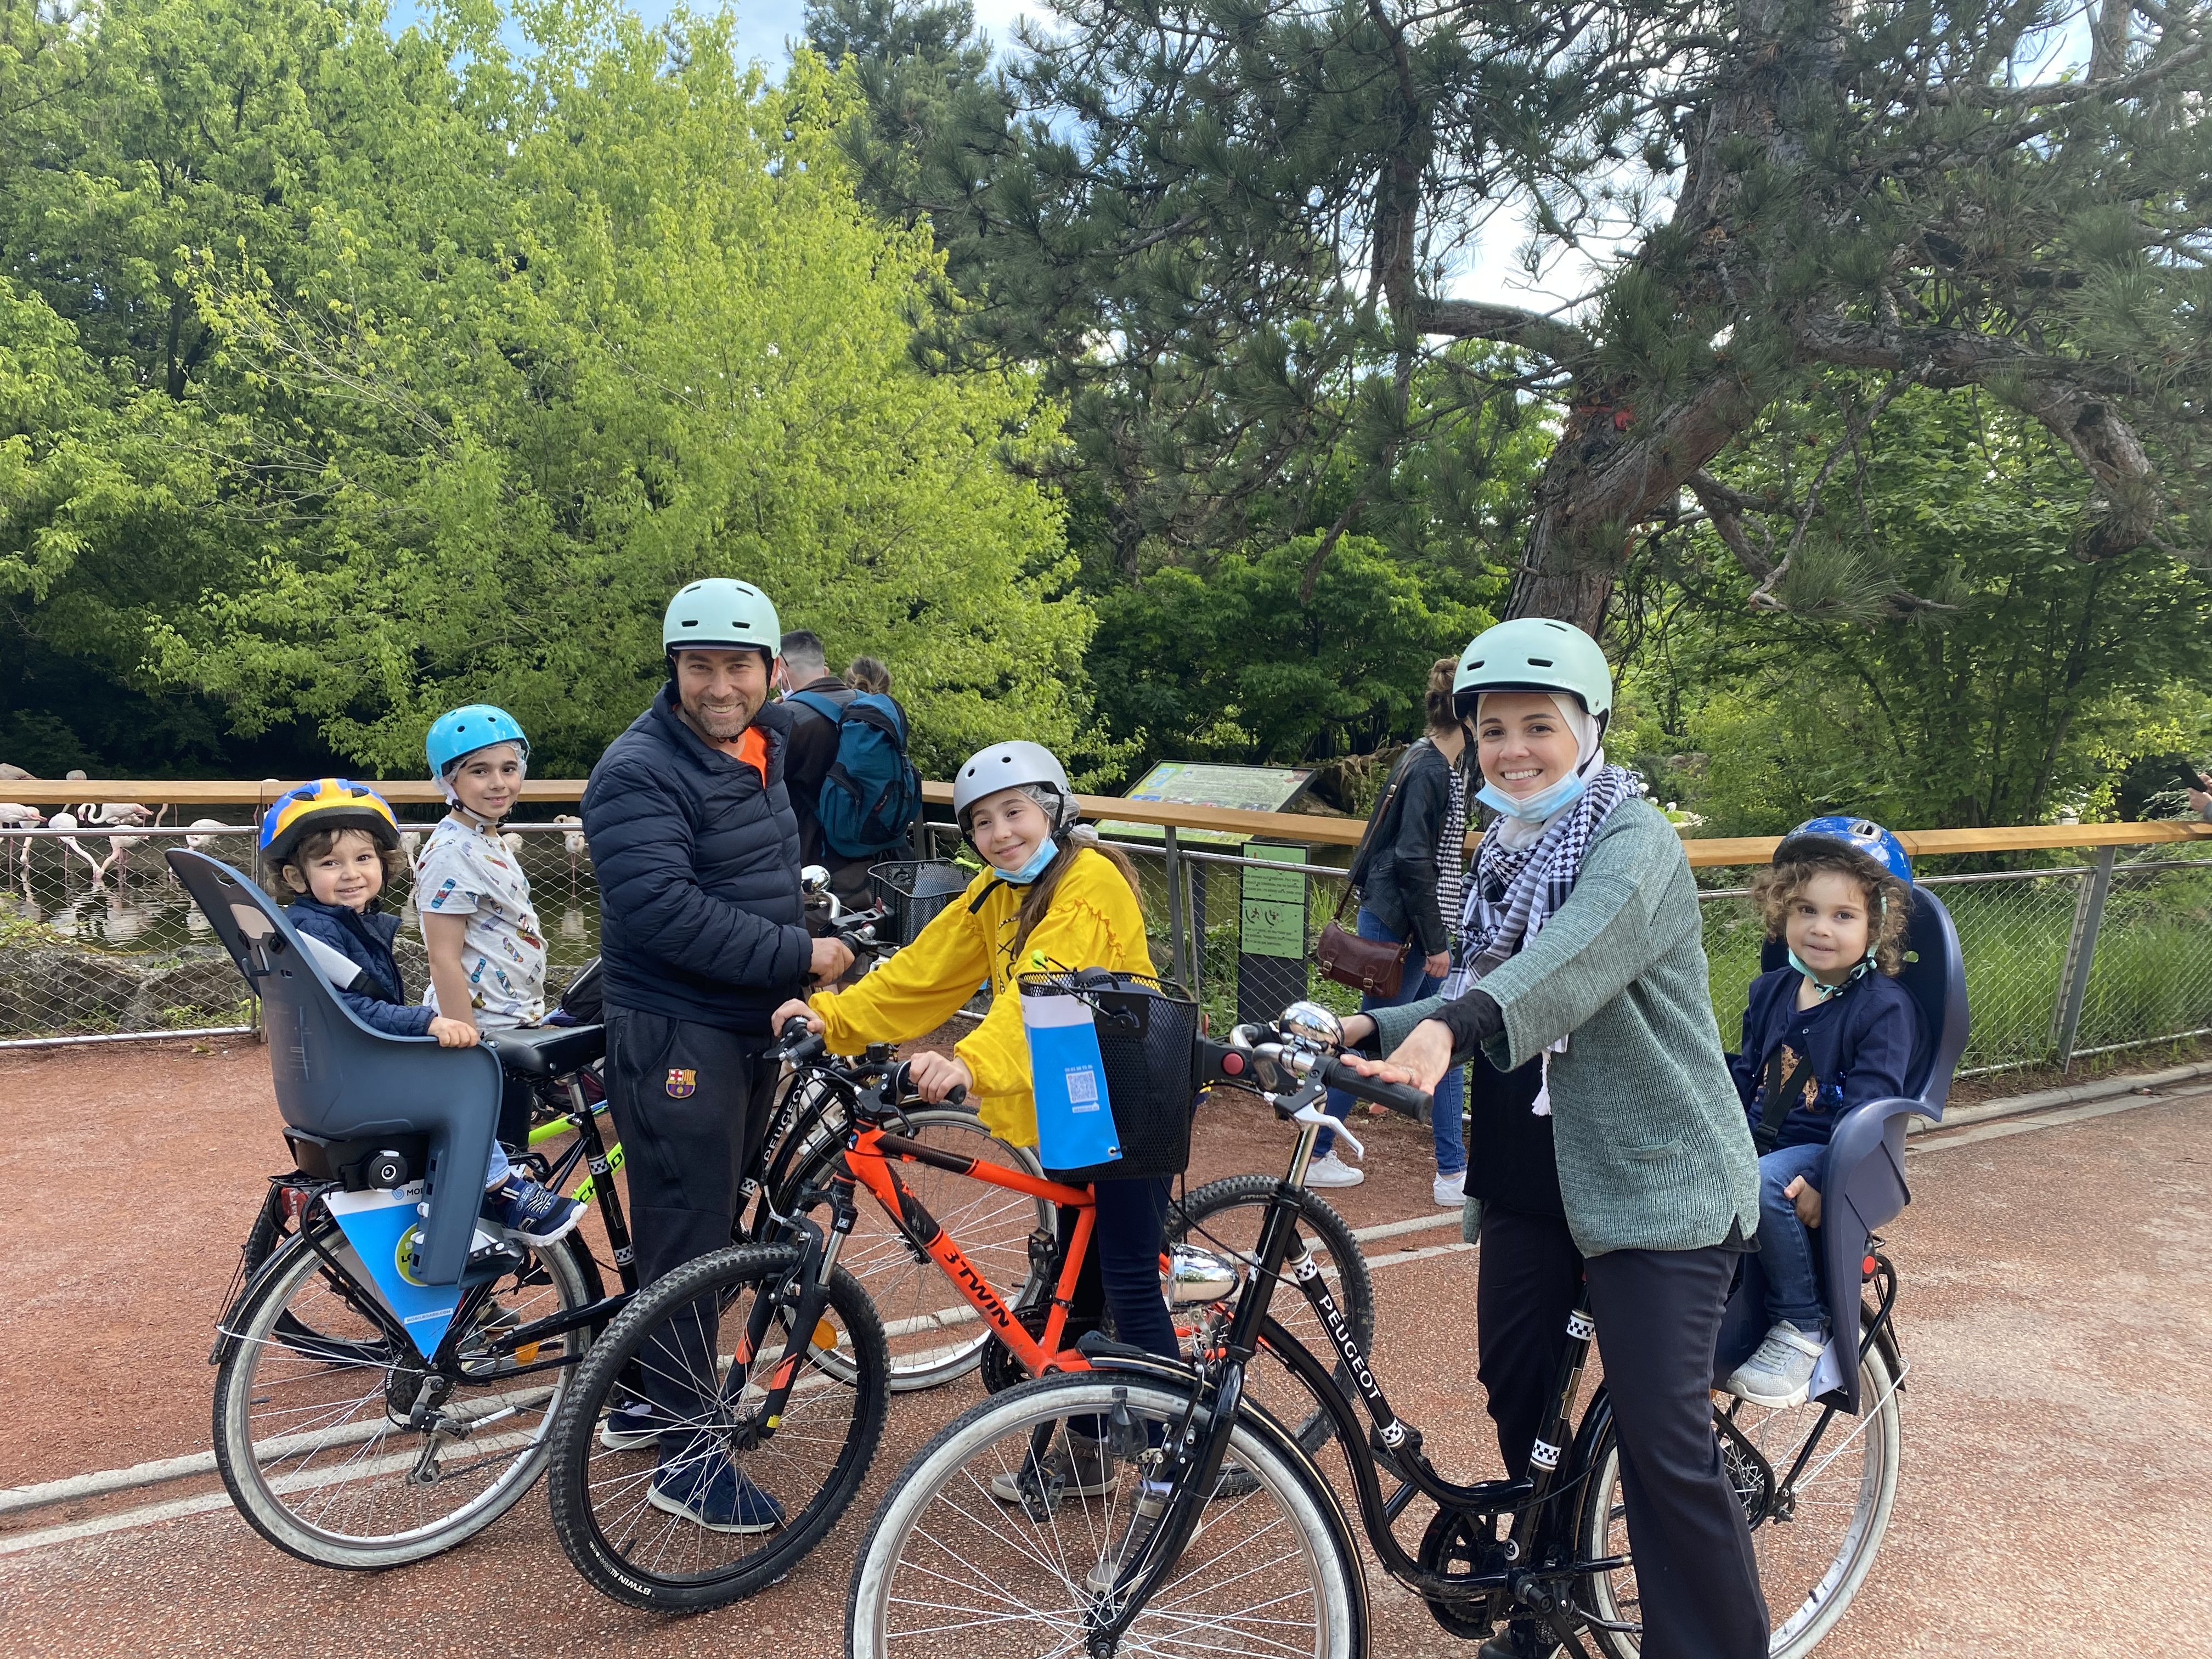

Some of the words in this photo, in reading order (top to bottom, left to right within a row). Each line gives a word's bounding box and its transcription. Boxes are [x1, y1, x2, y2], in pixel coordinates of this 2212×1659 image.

[764, 1080, 804, 1161] PEUGEOT
[386, 1354, 403, 1390] SHIMANO
[1319, 1294, 1381, 1399] PEUGEOT
